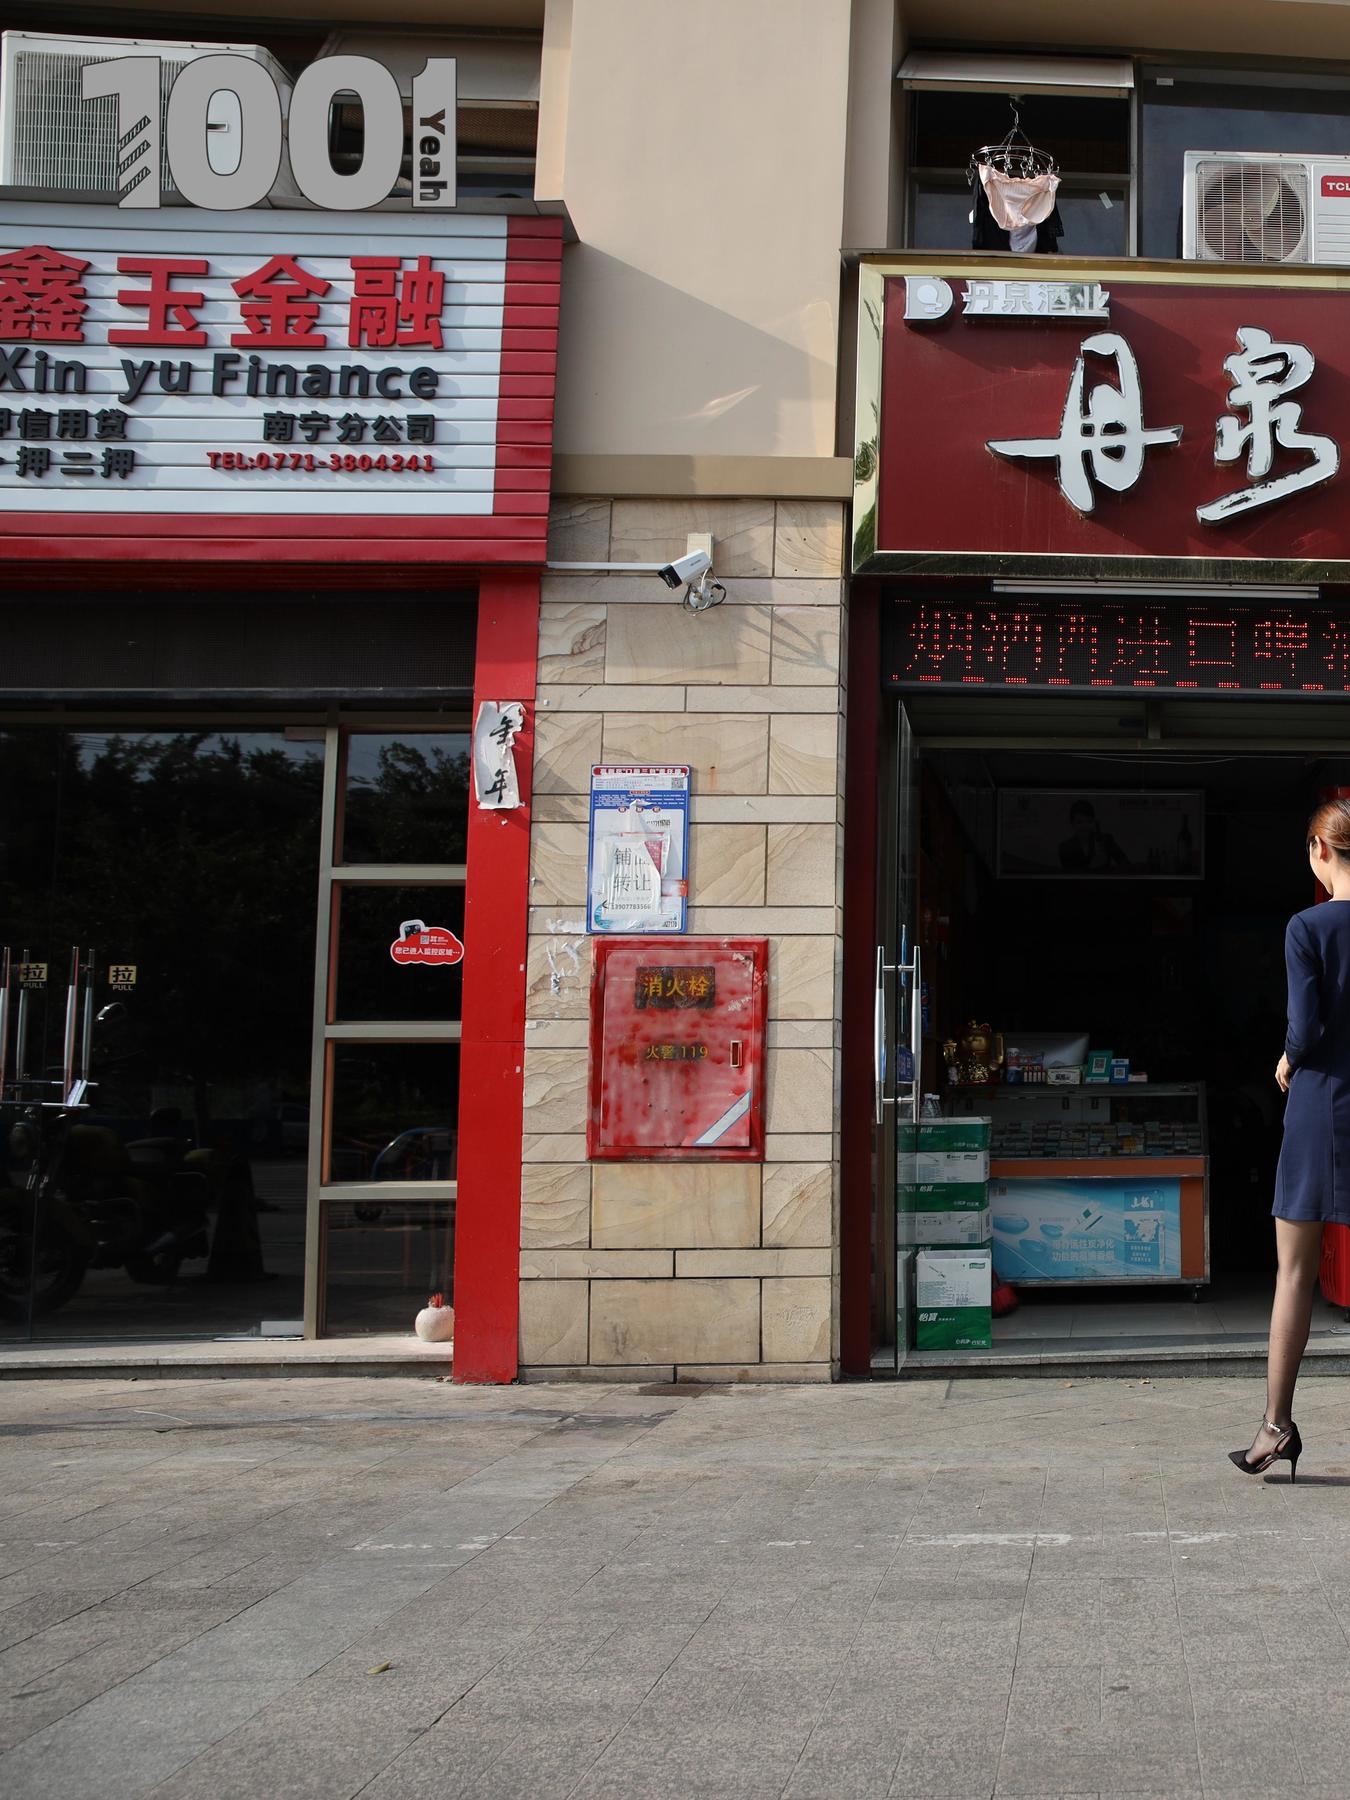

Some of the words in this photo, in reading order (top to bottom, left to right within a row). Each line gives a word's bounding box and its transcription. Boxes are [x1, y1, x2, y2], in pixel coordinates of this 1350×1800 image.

[0, 245, 444, 350] 鑫玉金融
[118, 358, 191, 403] yu
[212, 352, 440, 399] Finance
[262, 410, 437, 444] 南宁分公司
[0, 445, 135, 479] 押二押
[24, 964, 45, 980] 拉
[113, 967, 134, 982] 拉
[643, 975, 710, 997] 消火栓
[646, 1045, 675, 1060] 火警
[681, 1046, 709, 1058] 119
